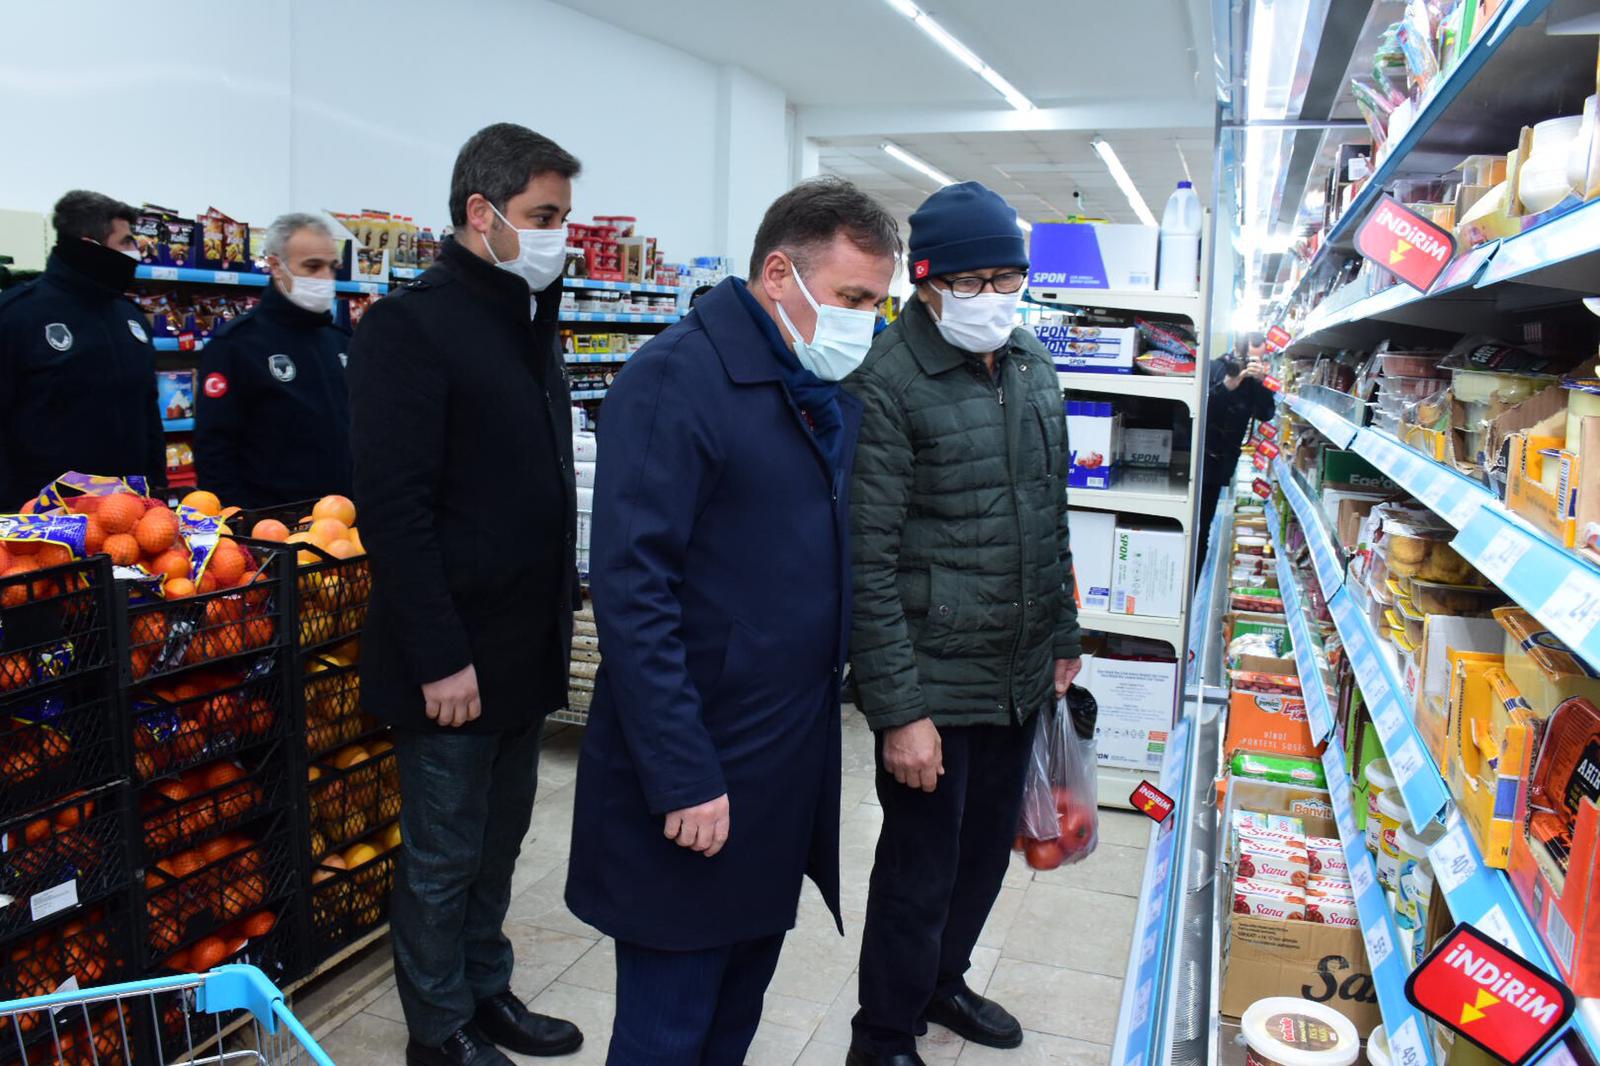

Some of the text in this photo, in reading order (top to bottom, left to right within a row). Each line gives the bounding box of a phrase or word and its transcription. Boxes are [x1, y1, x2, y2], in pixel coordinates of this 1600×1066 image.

[1032, 272, 1066, 284] SPON
[1131, 453, 1160, 464] SPON
[1119, 534, 1129, 560] SPON
[1294, 804, 1333, 819] Banvit
[1258, 863, 1289, 877] Sana
[1324, 857, 1348, 870] San
[1243, 881, 1295, 896] Sana
[1252, 903, 1284, 918] Sana
[1327, 912, 1358, 926] Sana
[1301, 955, 1380, 1004] Sa
